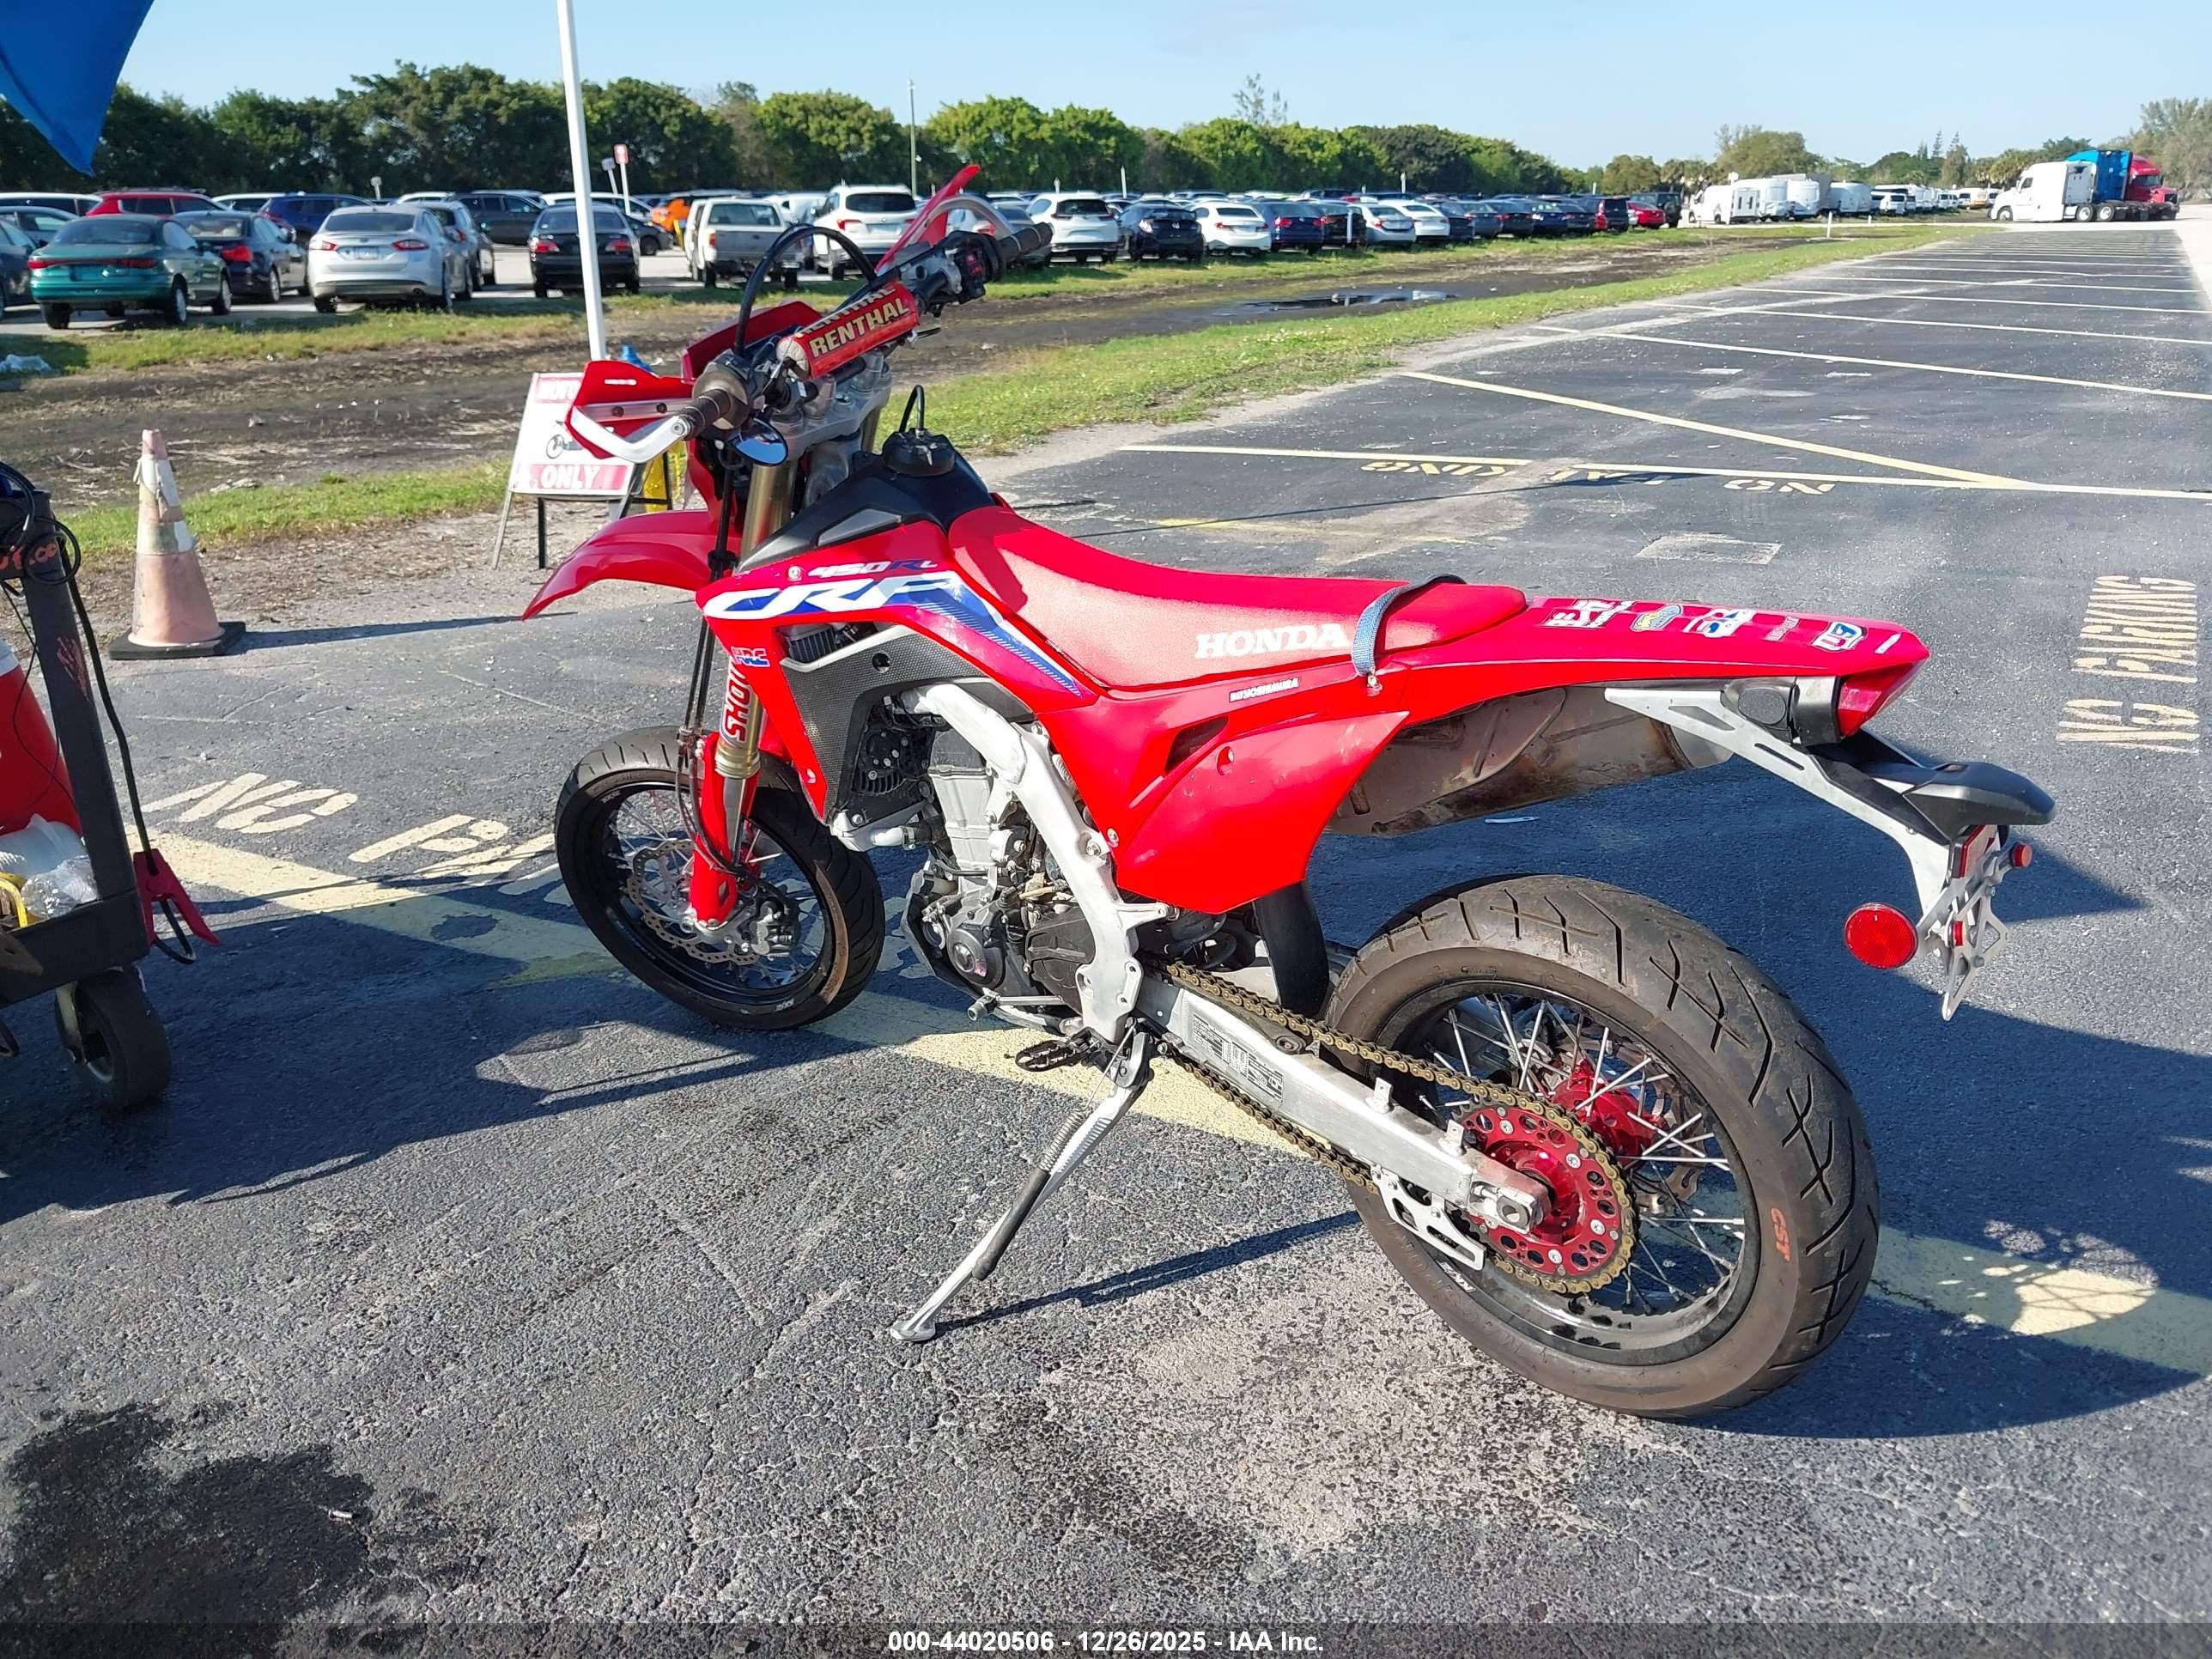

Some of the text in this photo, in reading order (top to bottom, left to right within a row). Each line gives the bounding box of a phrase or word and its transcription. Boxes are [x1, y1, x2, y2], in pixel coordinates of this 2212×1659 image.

[809, 297, 909, 358] RENTHAL
[541, 465, 601, 489] ONLY
[1723, 478, 1836, 495] NO
[704, 569, 960, 620] CRF
[730, 646, 770, 668] HRC
[1194, 623, 1350, 659] HONDA
[721, 655, 753, 744] SHO
[141, 772, 358, 835] NO
[1771, 1206, 1791, 1262] CST
